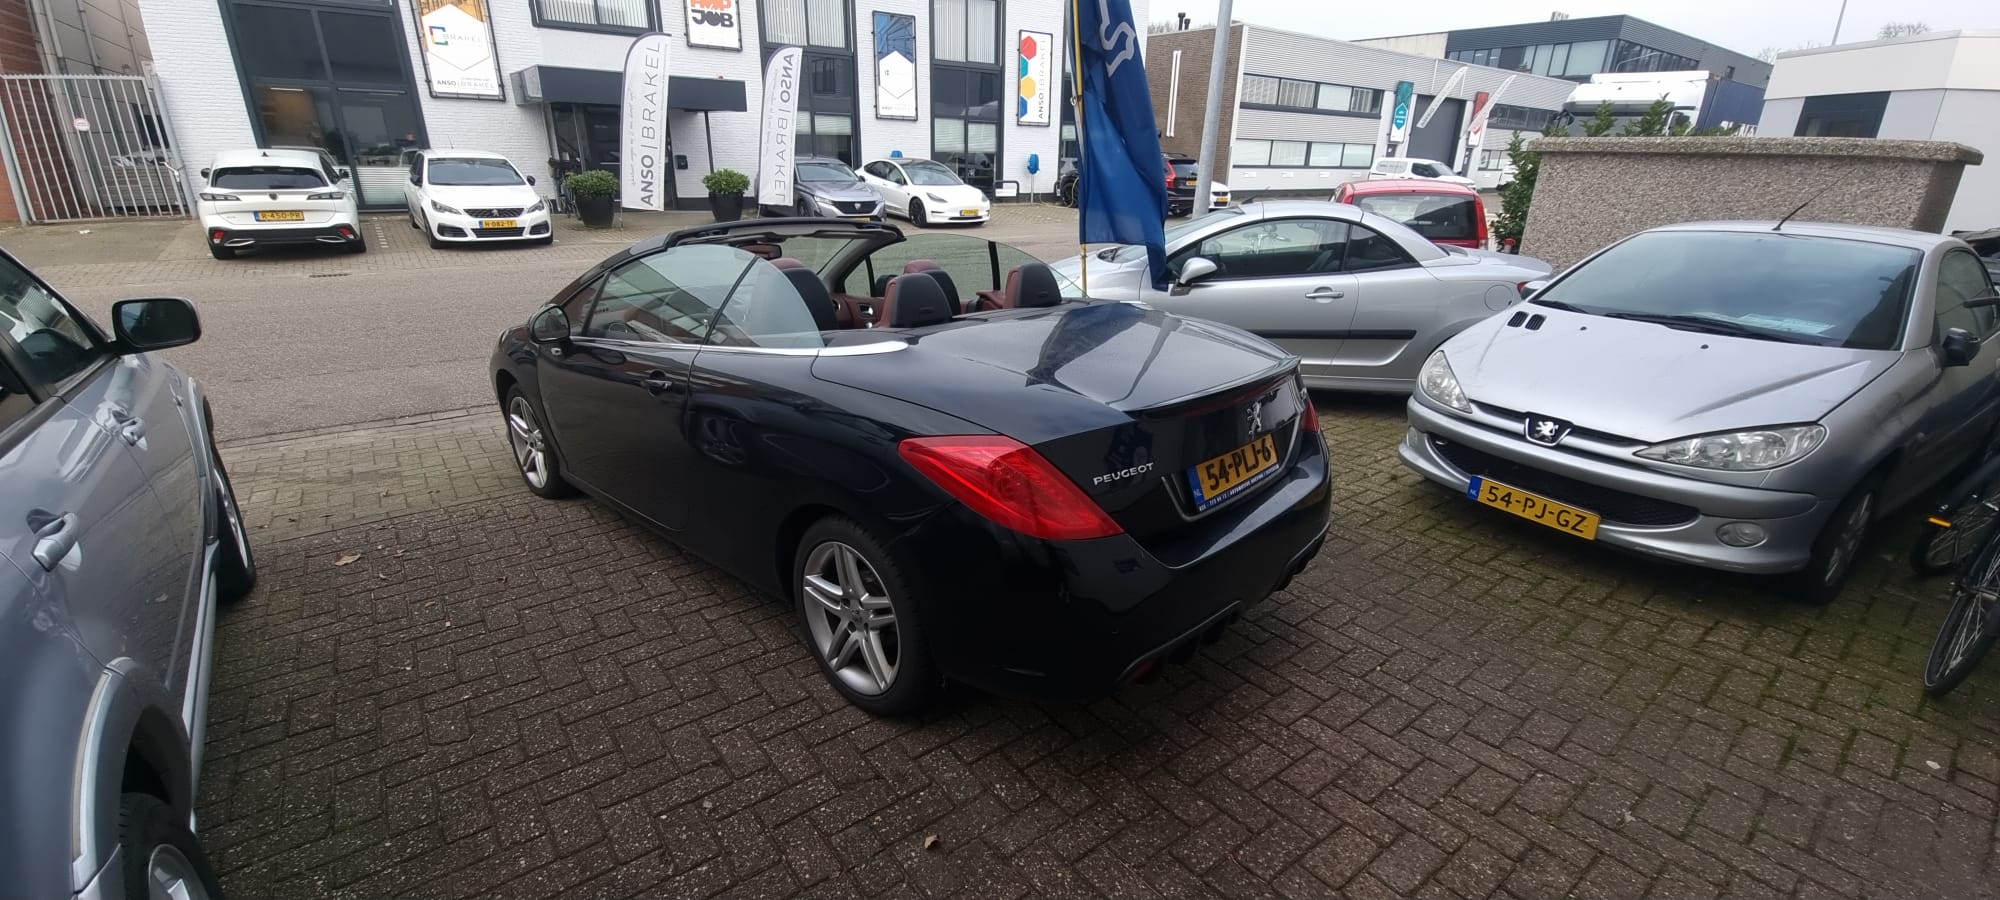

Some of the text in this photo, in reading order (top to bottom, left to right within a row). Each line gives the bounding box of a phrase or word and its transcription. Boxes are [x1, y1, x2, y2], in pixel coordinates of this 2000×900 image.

[691, 9, 734, 27] JOB
[640, 41, 660, 206] ANSO BRAKEL
[1093, 462, 1154, 486] PEUGEOT
[1205, 438, 1271, 491] 54-PLJ-6
[1469, 488, 1477, 496] NL
[1486, 485, 1588, 533] 54-PJ-GZ
